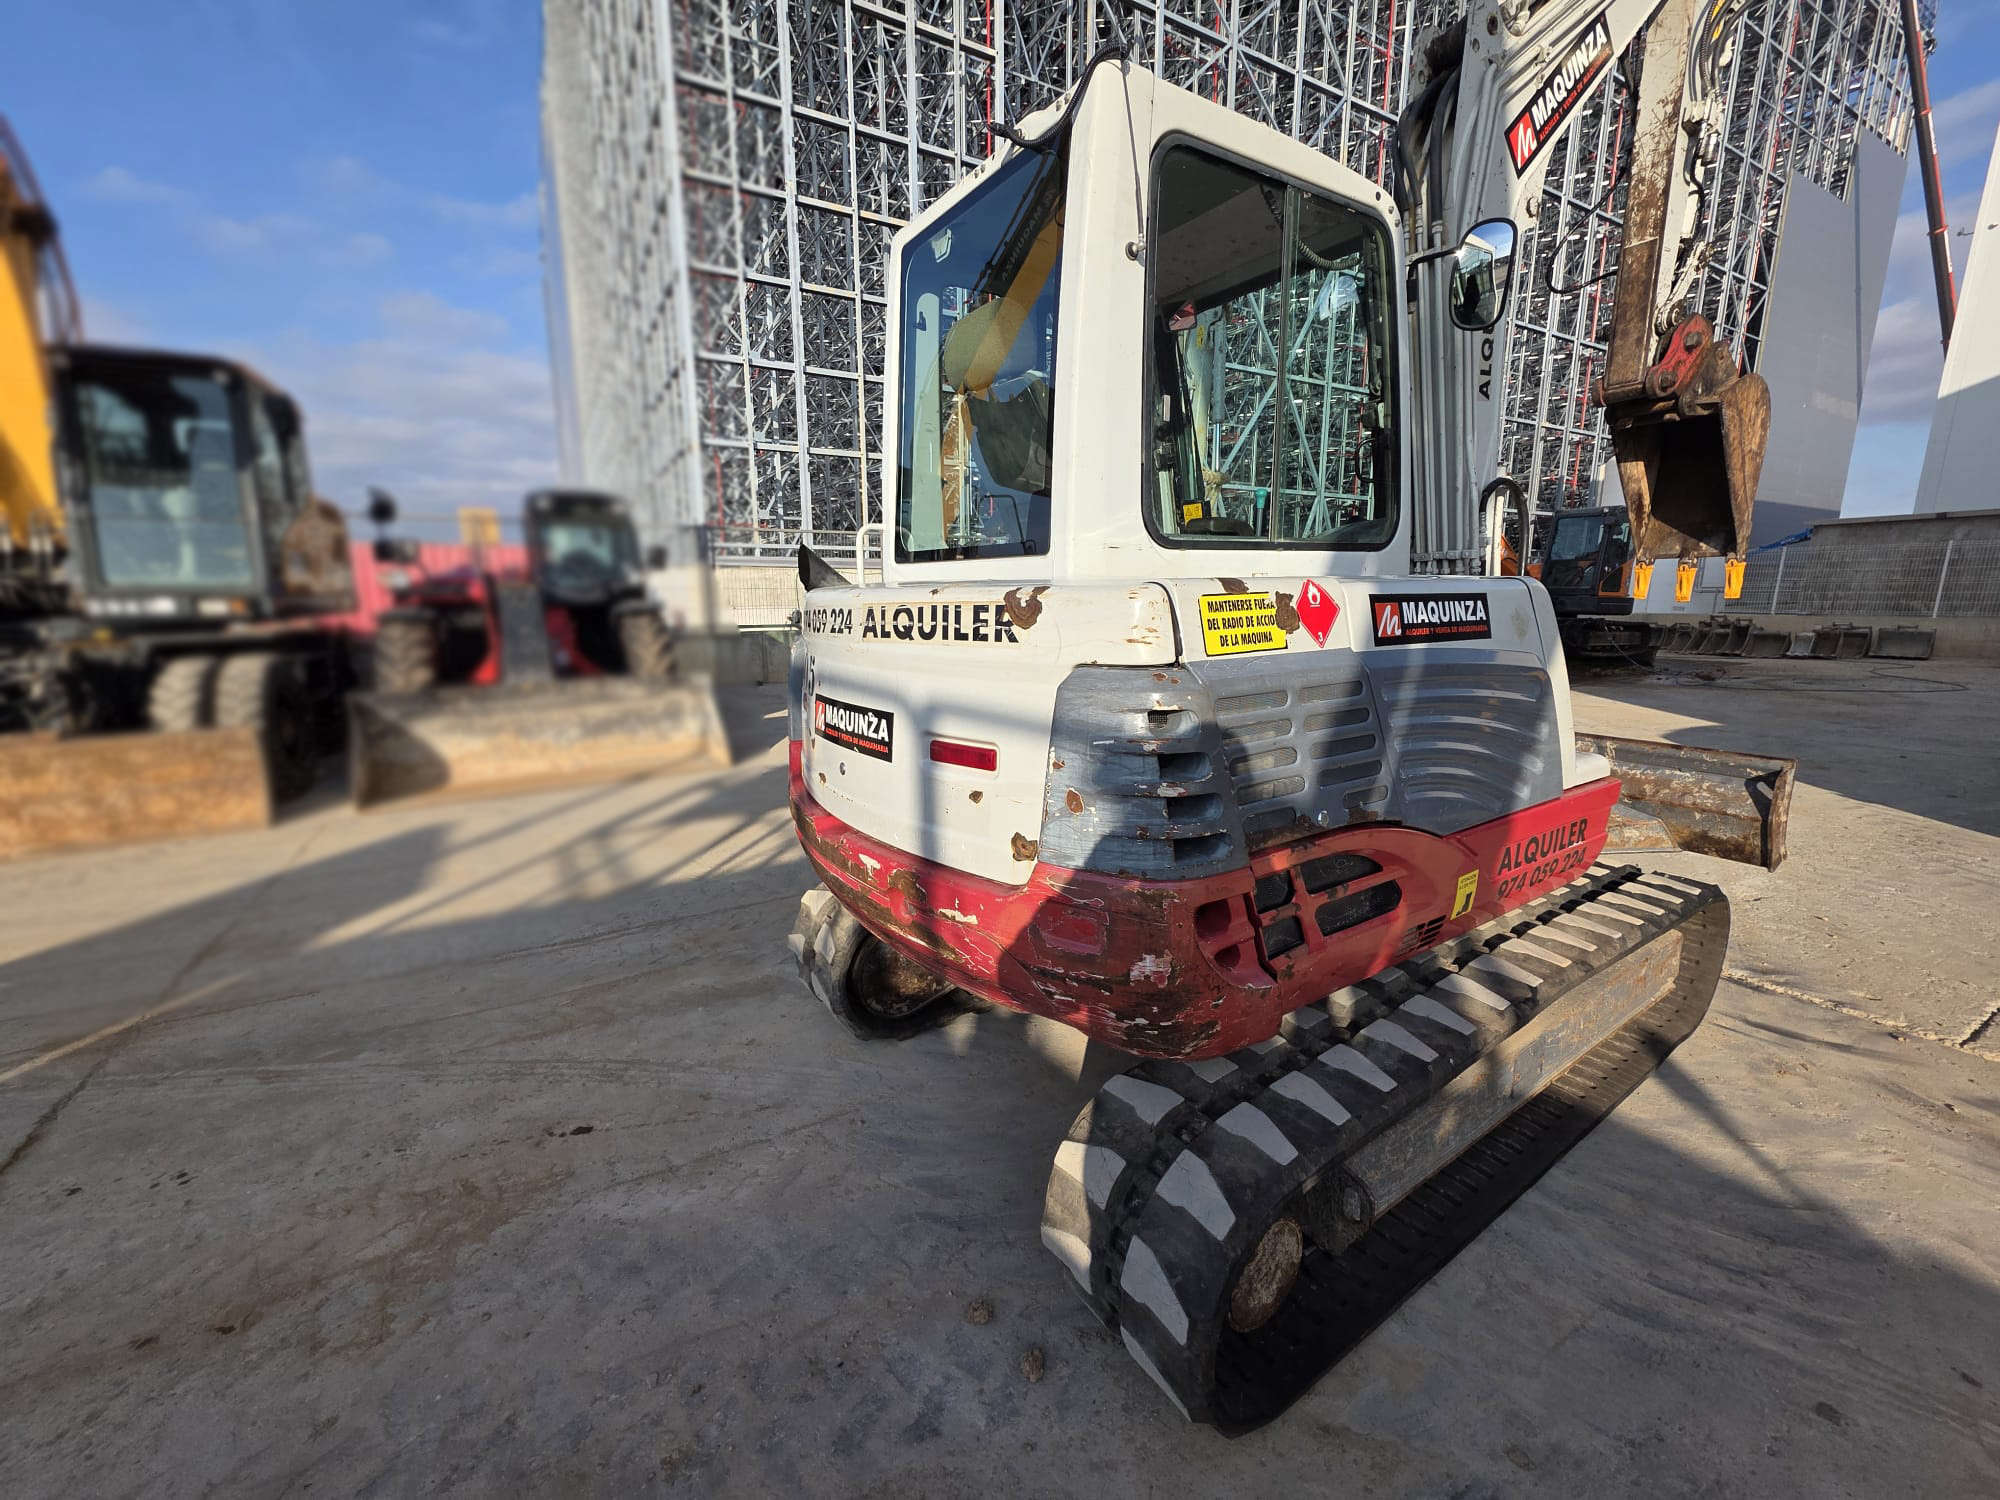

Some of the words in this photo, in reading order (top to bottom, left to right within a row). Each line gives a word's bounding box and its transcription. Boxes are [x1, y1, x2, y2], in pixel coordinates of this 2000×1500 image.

[1531, 22, 1608, 130] MAQUINZA
[1207, 599, 1253, 613] MANTENERSE
[1402, 600, 1487, 624] MAQUINZA
[812, 608, 828, 634] 059
[830, 608, 853, 635] 224
[862, 604, 1019, 643] ALQUILER
[1207, 618, 1221, 630] DEL
[1222, 615, 1244, 630] RADIO
[1245, 615, 1255, 628] DE
[1317, 632, 1324, 643] 3
[1220, 634, 1229, 647] DE
[1230, 633, 1240, 646] LA
[826, 703, 889, 742] MAQUINZA
[1498, 818, 1588, 875] ALQUILER
[1497, 873, 1527, 901] 974
[1529, 857, 1559, 888] 059
[1560, 847, 1588, 873] 224
